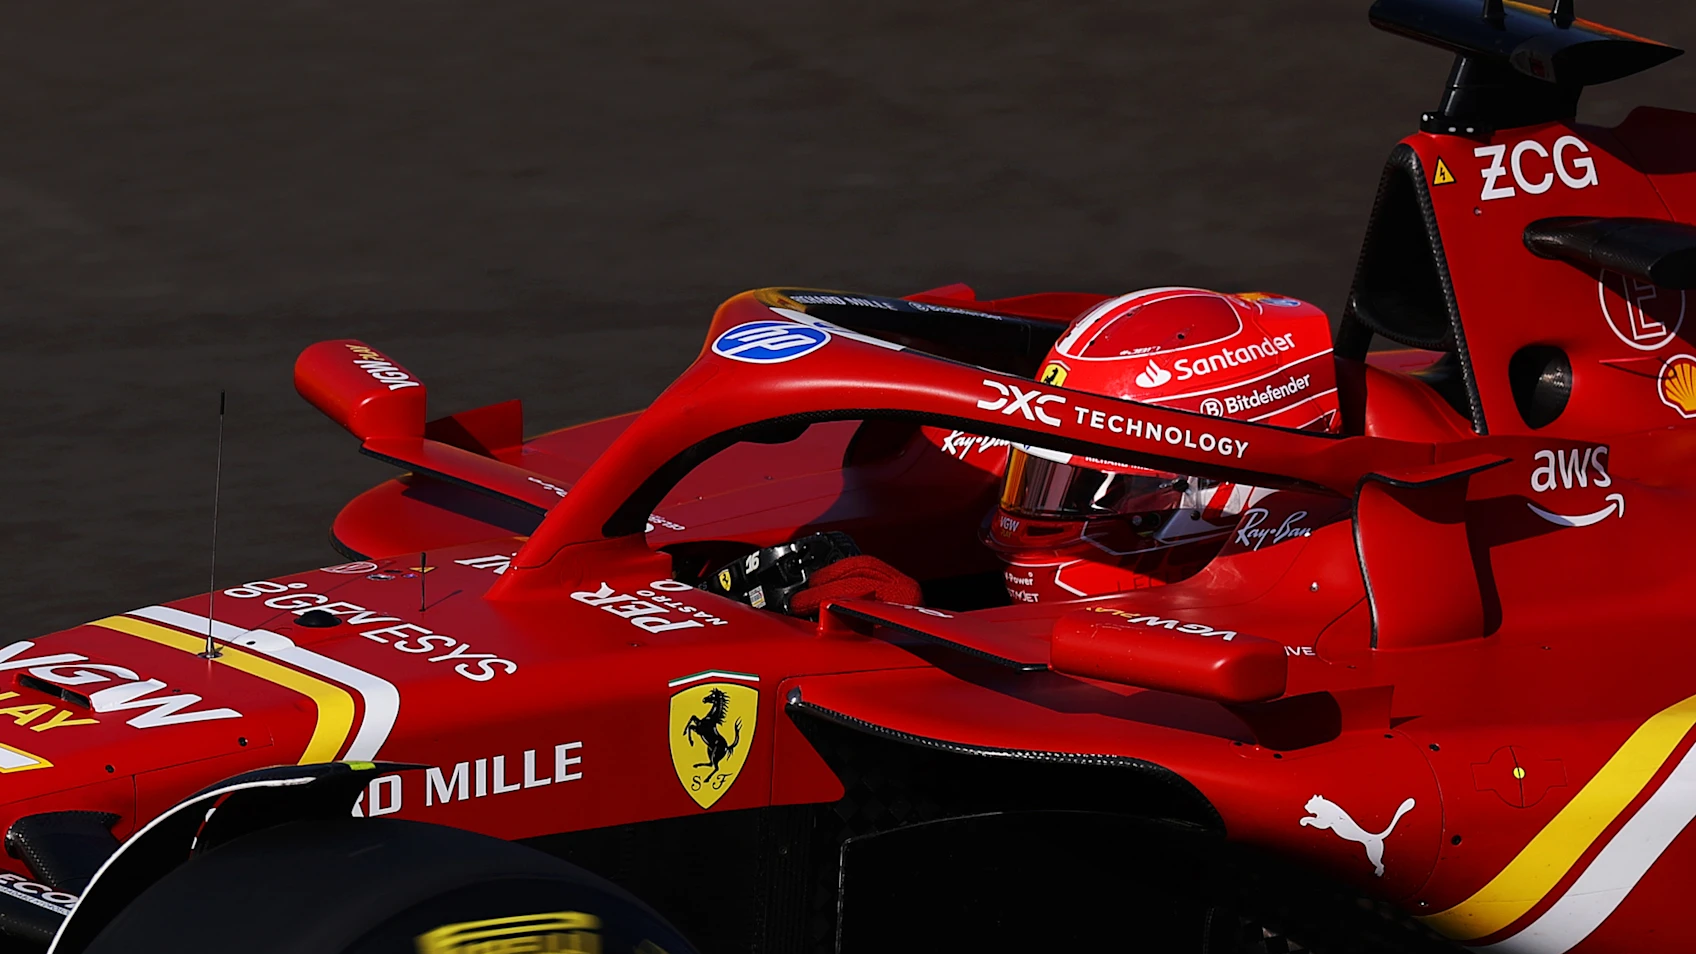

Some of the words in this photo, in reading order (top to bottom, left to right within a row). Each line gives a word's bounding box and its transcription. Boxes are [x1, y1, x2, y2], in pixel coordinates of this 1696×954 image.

[717, 322, 821, 358] hp
[1174, 332, 1296, 380] Santander
[353, 359, 420, 391] VGW
[1225, 374, 1310, 414] Bitdefender
[977, 379, 1066, 427] DXC
[1074, 405, 1249, 459] TECHNOLOGY
[1530, 443, 1612, 493] aws
[745, 551, 760, 575] 16
[636, 590, 729, 627] NASTRO
[1125, 615, 1238, 641] VGW
[264, 592, 518, 682] GENESYS
[426, 741, 583, 807] MILLE
